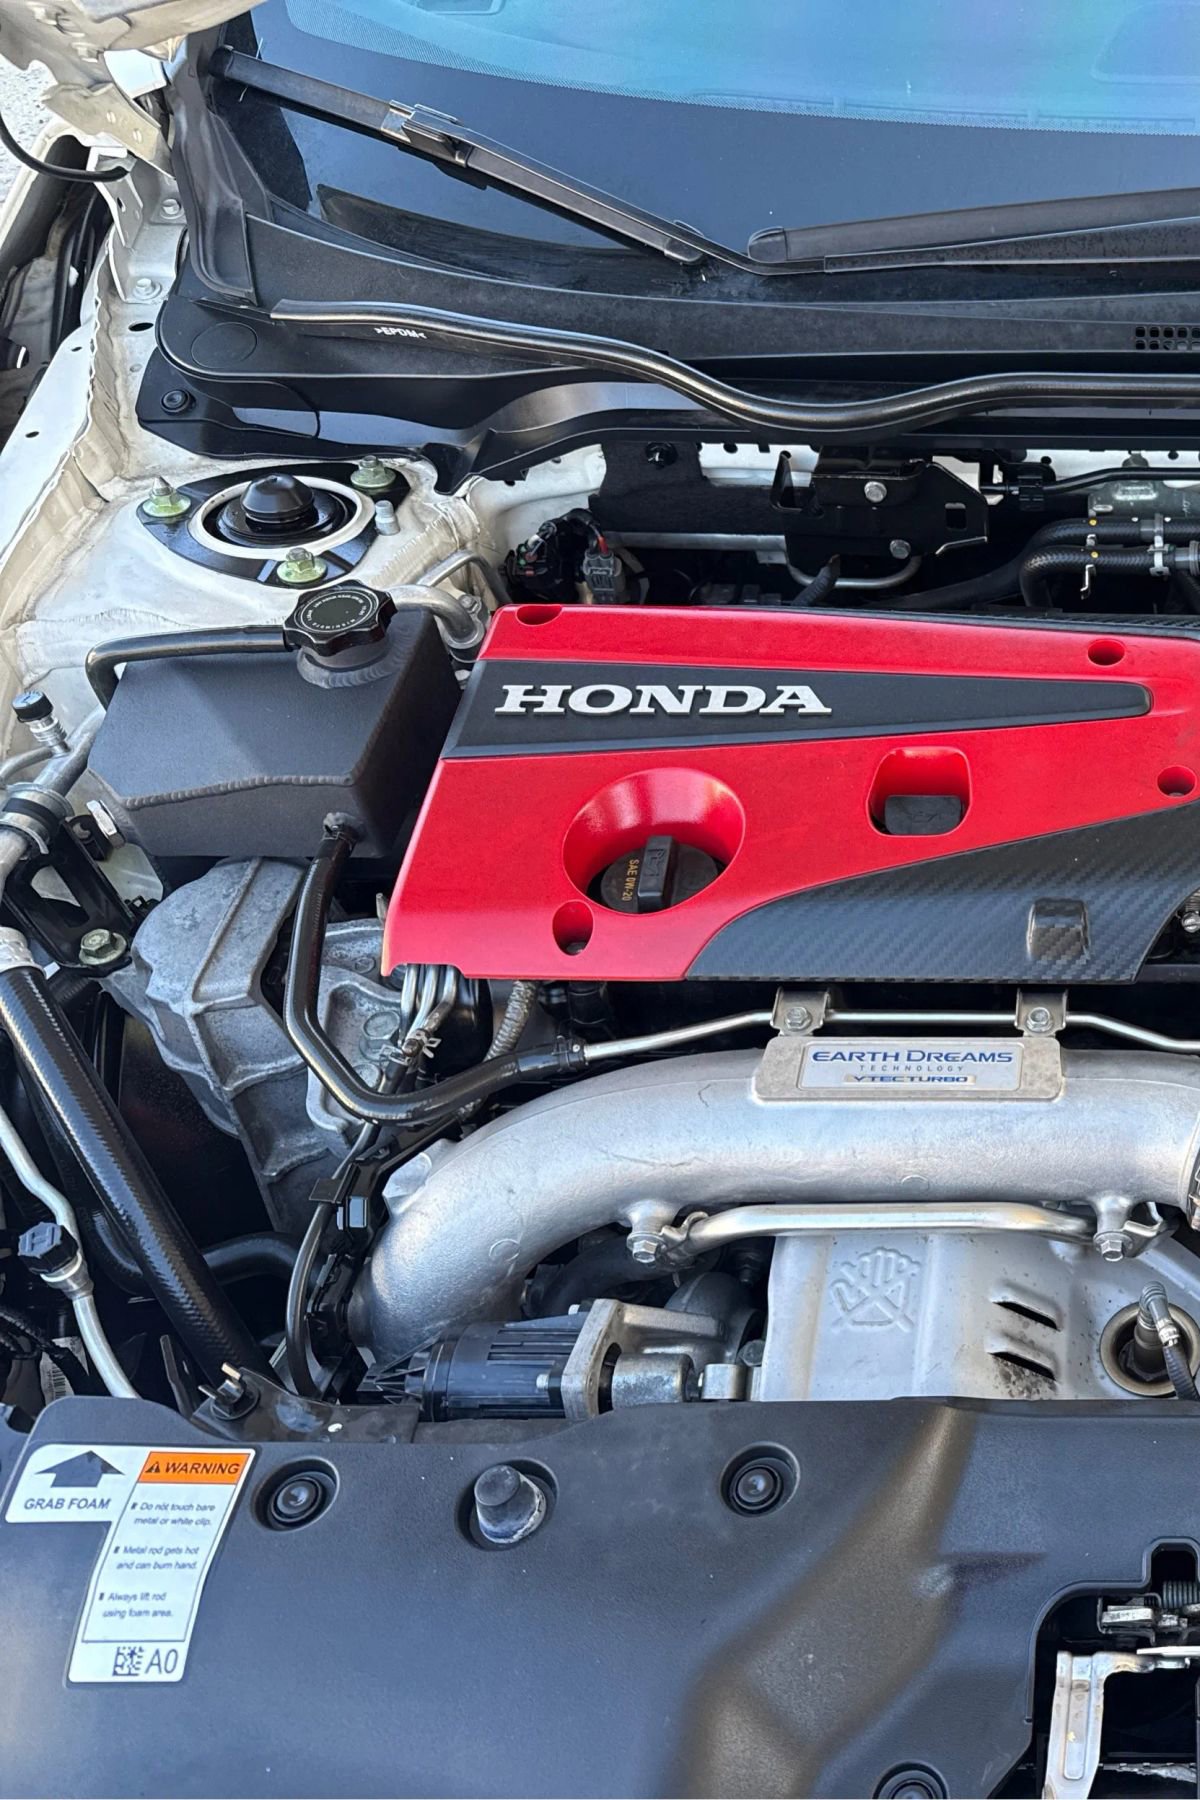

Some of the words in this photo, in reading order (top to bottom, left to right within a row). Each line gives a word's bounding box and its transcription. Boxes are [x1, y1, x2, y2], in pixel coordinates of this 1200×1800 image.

[494, 684, 833, 715] HONDA
[626, 859, 640, 876] SAE
[812, 1051, 900, 1063] EARTH
[906, 1050, 1013, 1063] DREAMS
[165, 1462, 240, 1475] WARNING
[24, 1498, 64, 1510] GRAB
[67, 1498, 111, 1510] FOAM
[140, 1502, 153, 1511] Do
[155, 1502, 169, 1511] not
[170, 1503, 194, 1511] touch
[195, 1503, 216, 1511] bare
[134, 1517, 159, 1525] metal
[160, 1517, 169, 1525] or
[170, 1517, 193, 1525] white
[123, 1545, 147, 1554] Metal
[148, 1545, 163, 1554] rod
[164, 1546, 183, 1556] gets
[185, 1546, 200, 1554] hot
[116, 1561, 135, 1569] and
[135, 1561, 151, 1569] can
[108, 1592, 138, 1603] Always
[140, 1592, 150, 1601] lift
[152, 1592, 167, 1601] rod
[102, 1608, 127, 1619] using
[128, 1607, 150, 1617] foam
